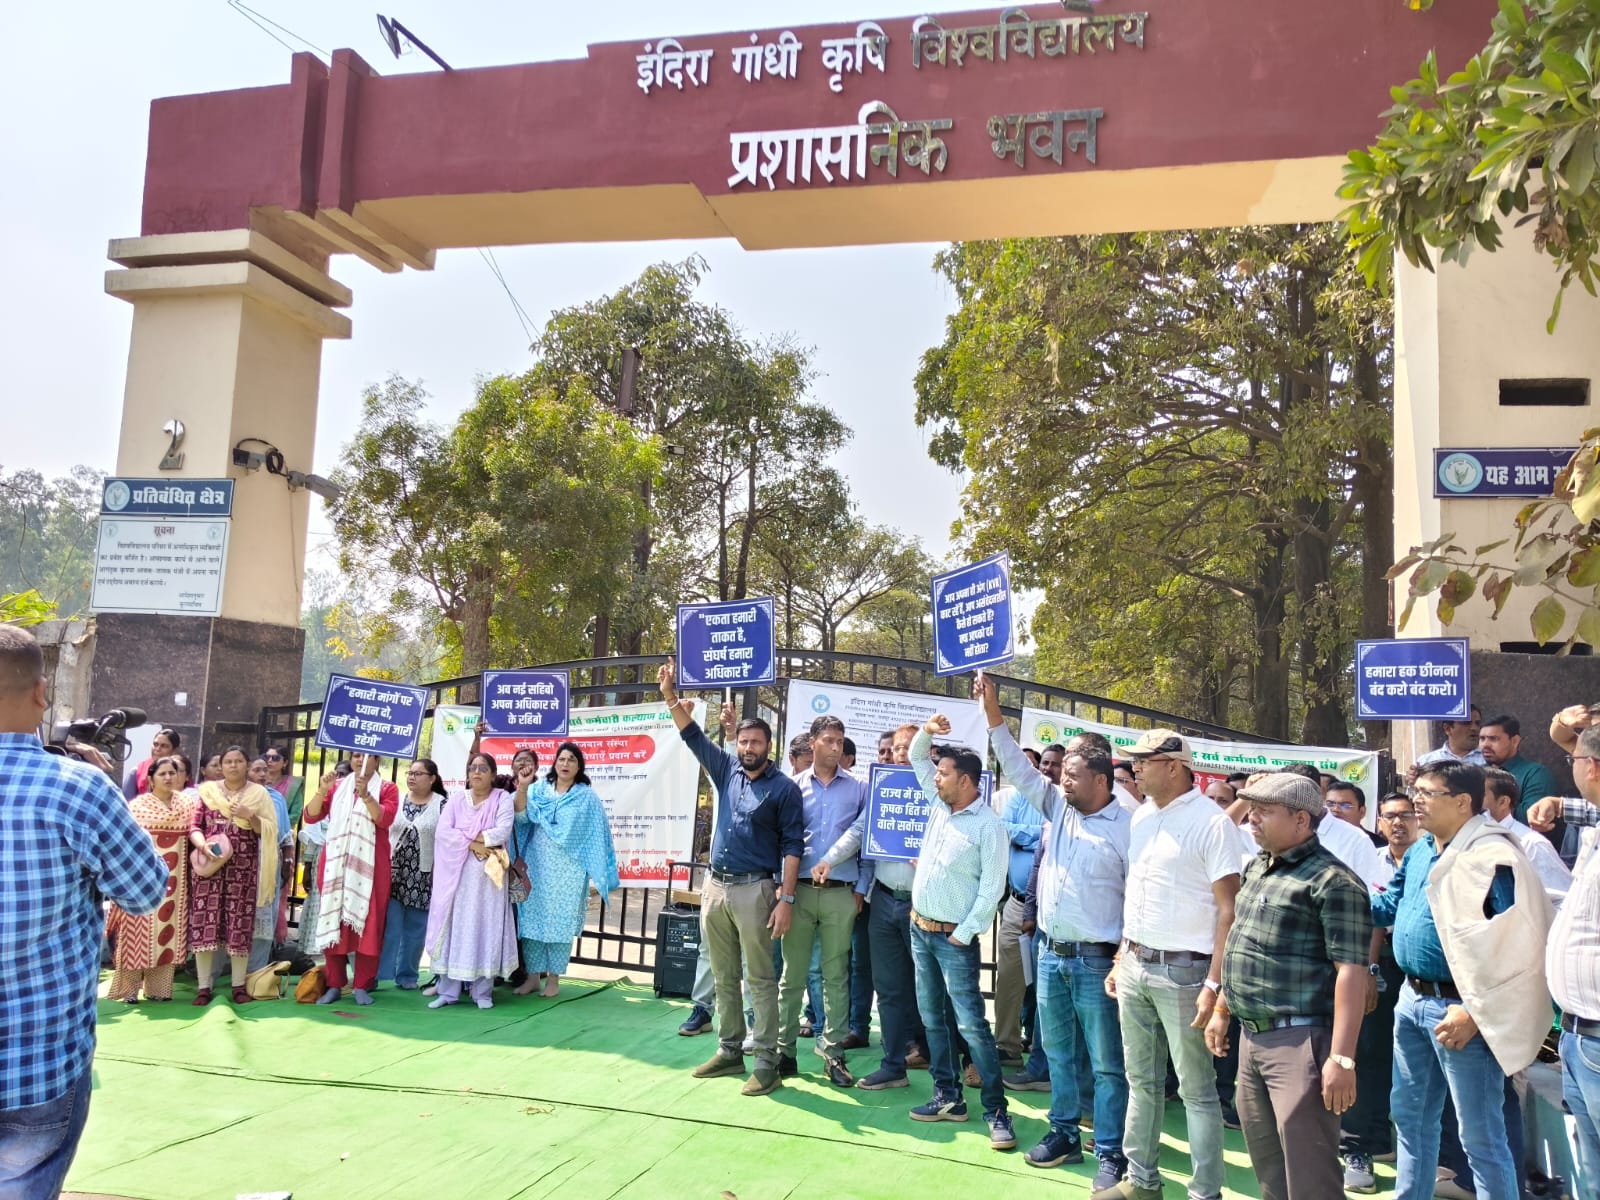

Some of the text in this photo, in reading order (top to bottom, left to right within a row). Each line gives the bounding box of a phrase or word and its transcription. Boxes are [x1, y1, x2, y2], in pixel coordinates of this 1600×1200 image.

[636, 8, 1149, 95] इंदिरा गांधी कृषि विश्वविद्यालय
[727, 100, 1104, 191] प्रशासनिक भवन
[159, 419, 185, 470] 2
[1485, 465, 1509, 485] यह
[1514, 465, 1549, 485] आम
[133, 486, 225, 505] प्रतिबंधित क्षेत्र
[732, 607, 756, 624] हमारी
[710, 626, 746, 643] ताकत है,
[702, 646, 754, 661] संघर्ष हमारा
[705, 664, 741, 679] अधिकार
[1364, 661, 1459, 678] हमारा हक छीनना
[497, 684, 511, 695] अब
[512, 681, 527, 695] नई
[1368, 680, 1457, 696] बंद करो बंद करो।
[377, 691, 401, 704] मांगों
[401, 695, 414, 706] पर
[491, 697, 560, 710] अपन अधिकार ले
[355, 703, 392, 720] ध्यान दो,
[507, 711, 543, 725] के रहिबो
[328, 714, 413, 737] नहीं तो हड़ताल जारी
[1201, 751, 1220, 762] सर्व
[880, 787, 902, 799] राज्य
[903, 786, 914, 799] में
[880, 803, 903, 818] कृषक
[905, 802, 923, 816] हित
[877, 817, 924, 833] वाले सर्वोच्च
